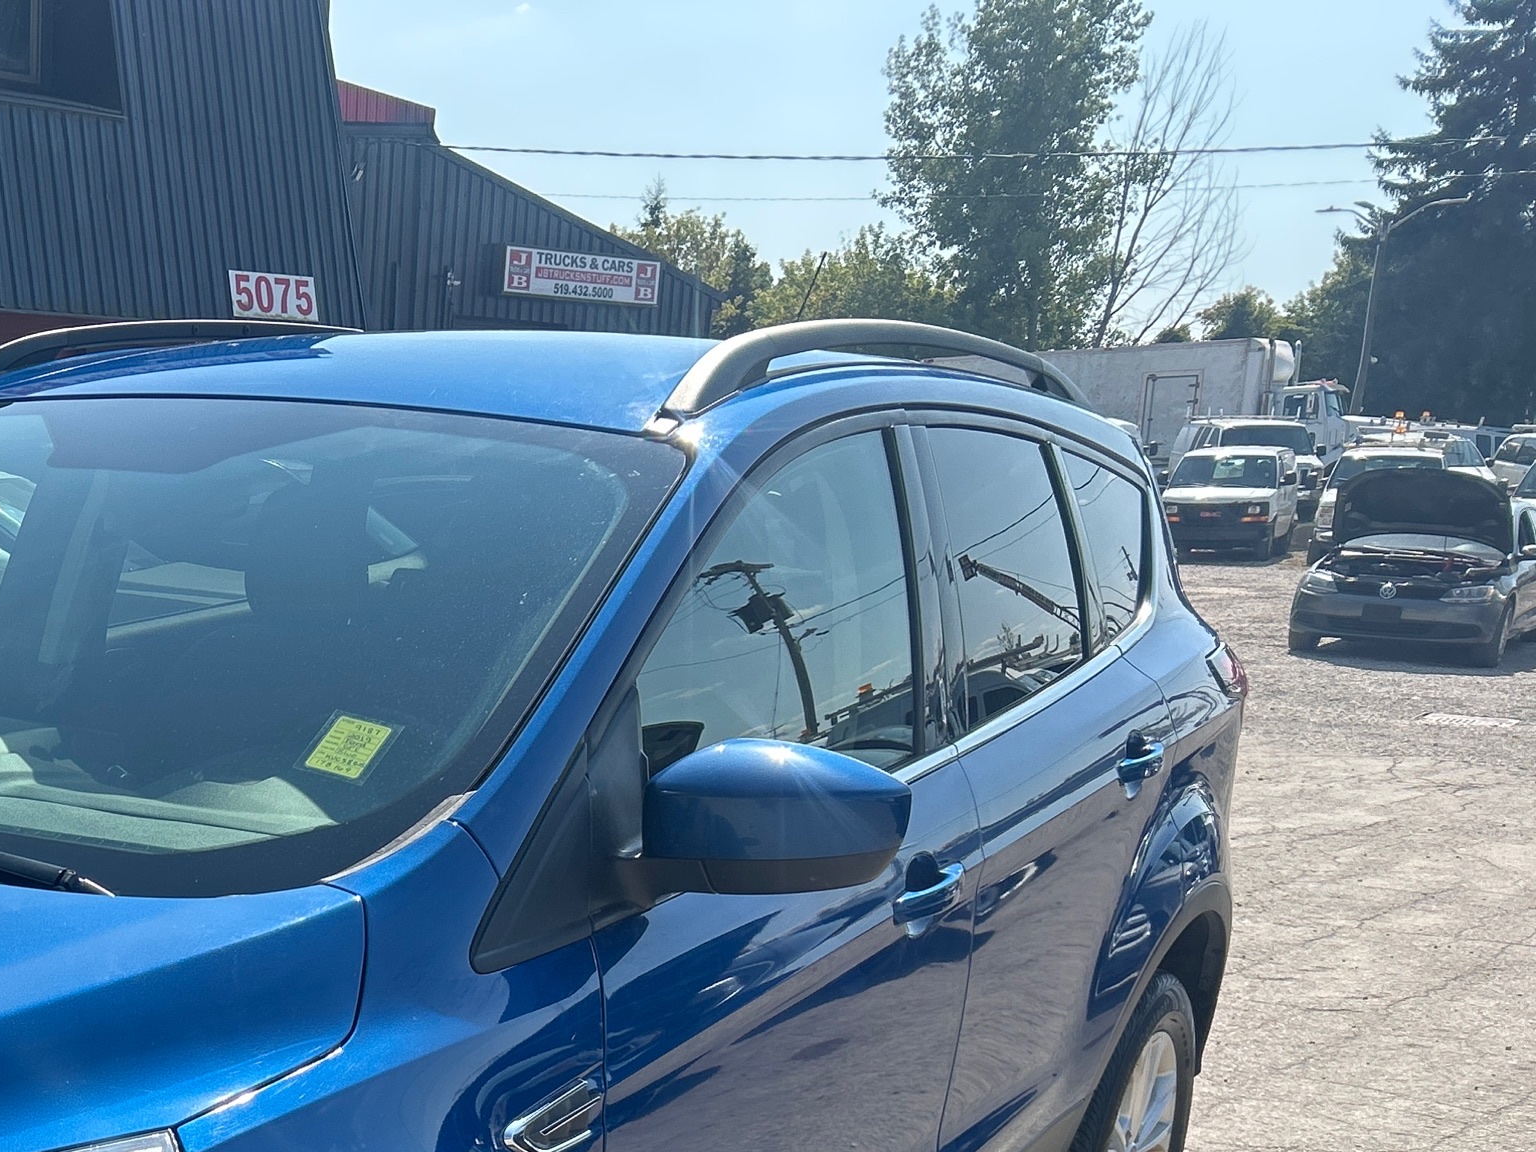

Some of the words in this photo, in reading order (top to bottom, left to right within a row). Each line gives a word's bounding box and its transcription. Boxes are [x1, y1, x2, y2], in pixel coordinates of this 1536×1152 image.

[513, 253, 528, 265] J
[536, 252, 587, 268] TRUCKS
[589, 257, 599, 270] &
[602, 259, 634, 273] CARS
[537, 269, 631, 284] JBTRUCKSNSTUFF.COM
[639, 266, 655, 278] J
[511, 274, 527, 287] B
[235, 274, 313, 316] 5075
[553, 283, 613, 299] 519.432.5000
[638, 287, 653, 299] B
[355, 725, 381, 735] 9187
